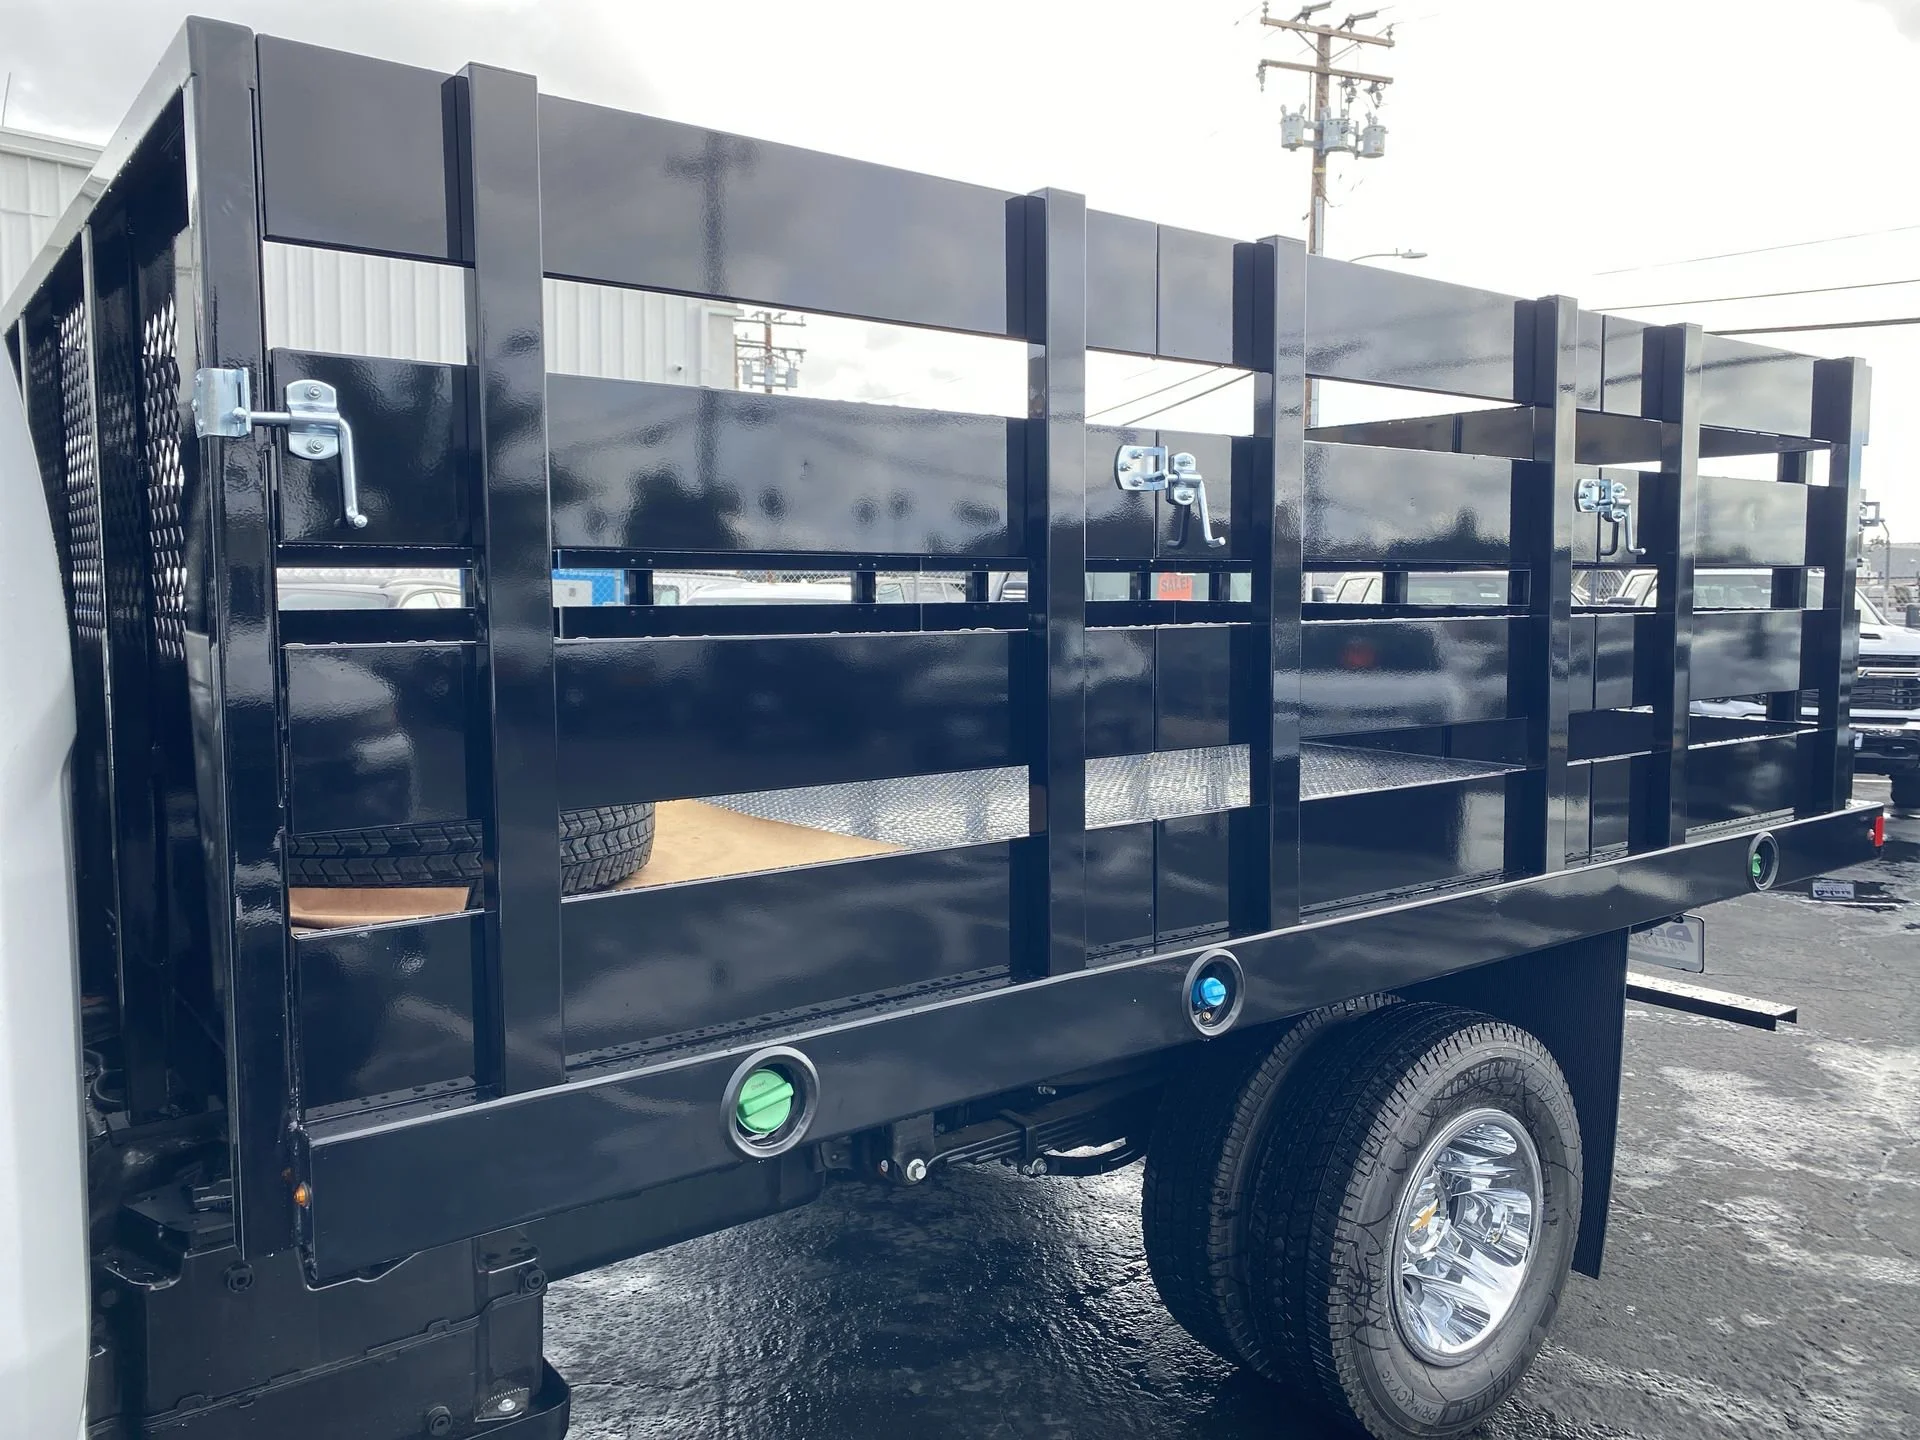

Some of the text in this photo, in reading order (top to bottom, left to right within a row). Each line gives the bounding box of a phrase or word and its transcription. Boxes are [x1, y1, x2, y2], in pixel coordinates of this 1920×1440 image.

[1162, 576, 1189, 592] SALE!
[1381, 1370, 1439, 1421] PRIMACY XC
